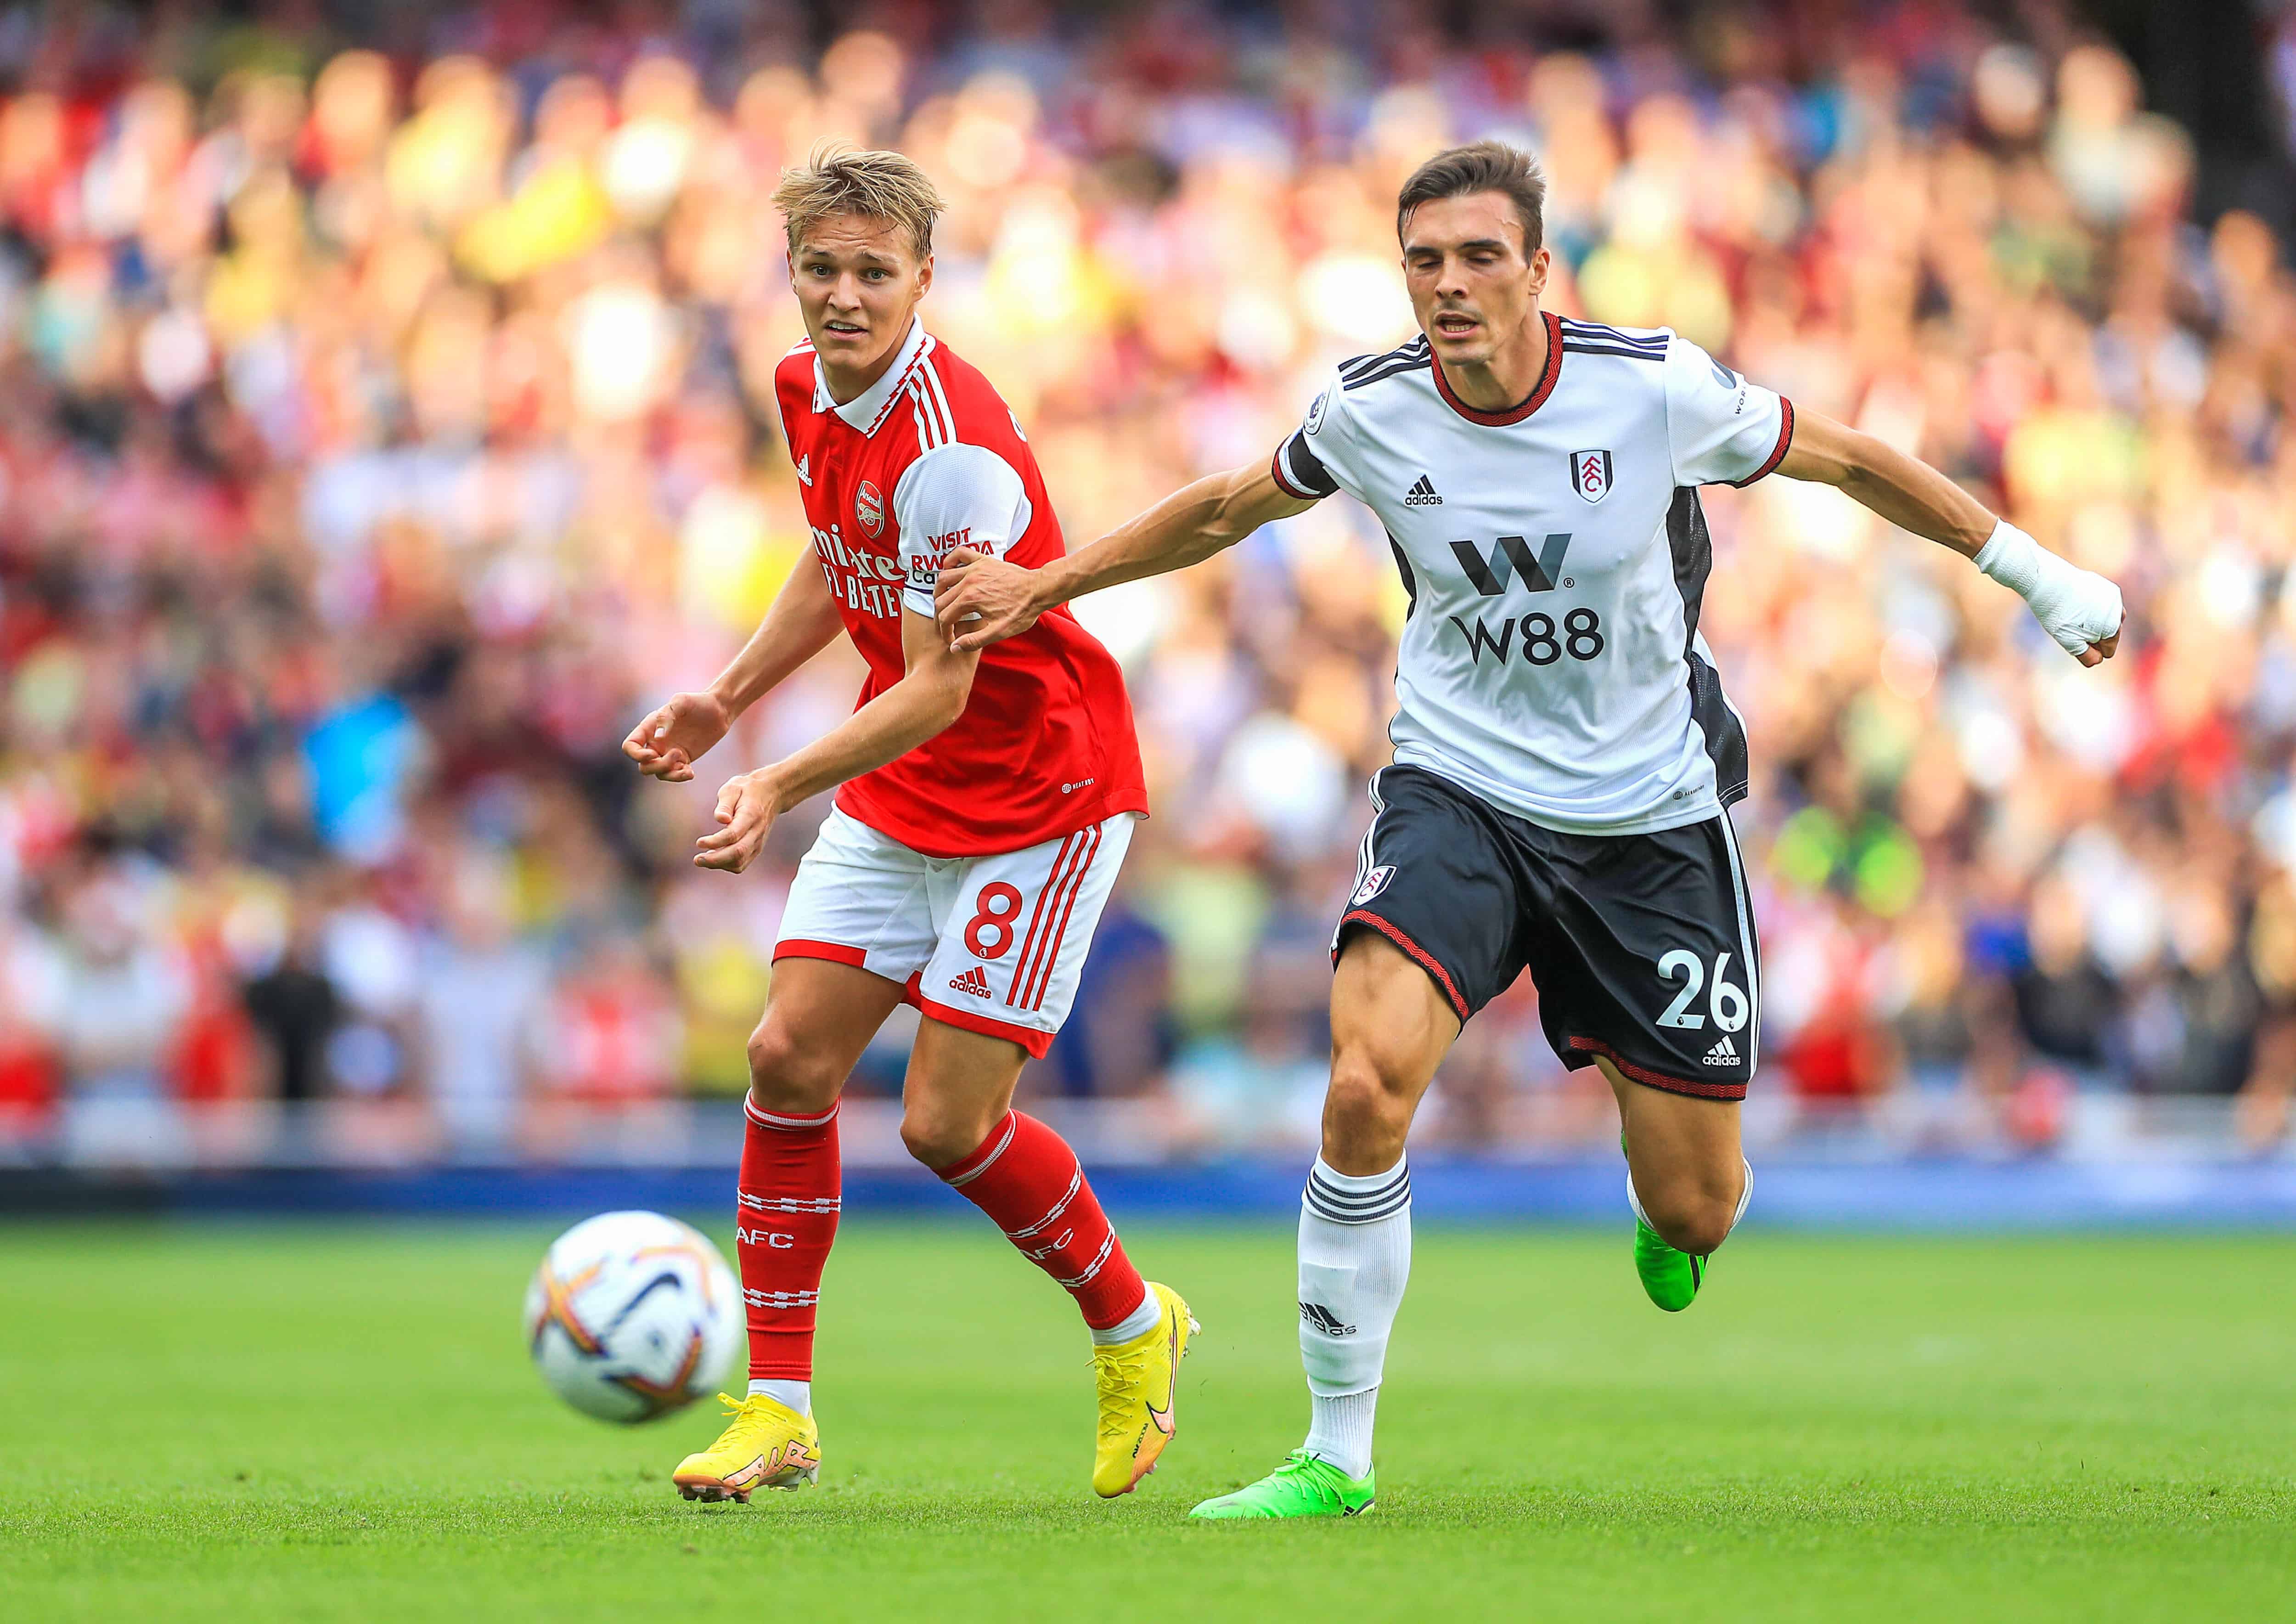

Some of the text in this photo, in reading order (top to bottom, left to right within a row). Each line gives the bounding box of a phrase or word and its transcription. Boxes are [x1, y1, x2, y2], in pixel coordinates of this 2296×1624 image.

[1735, 386, 1745, 414] WOR
[861, 488, 880, 508] Arsenal
[1405, 493, 1443, 506] adidas
[928, 527, 971, 552] VISIT
[822, 563, 844, 598] FL
[1449, 608, 1604, 666] W88
[964, 881, 1023, 960] 8
[949, 978, 992, 999] adidas
[1656, 949, 1749, 1033] 26
[1703, 1054, 1741, 1066] adidas
[736, 1226, 794, 1249] AFC
